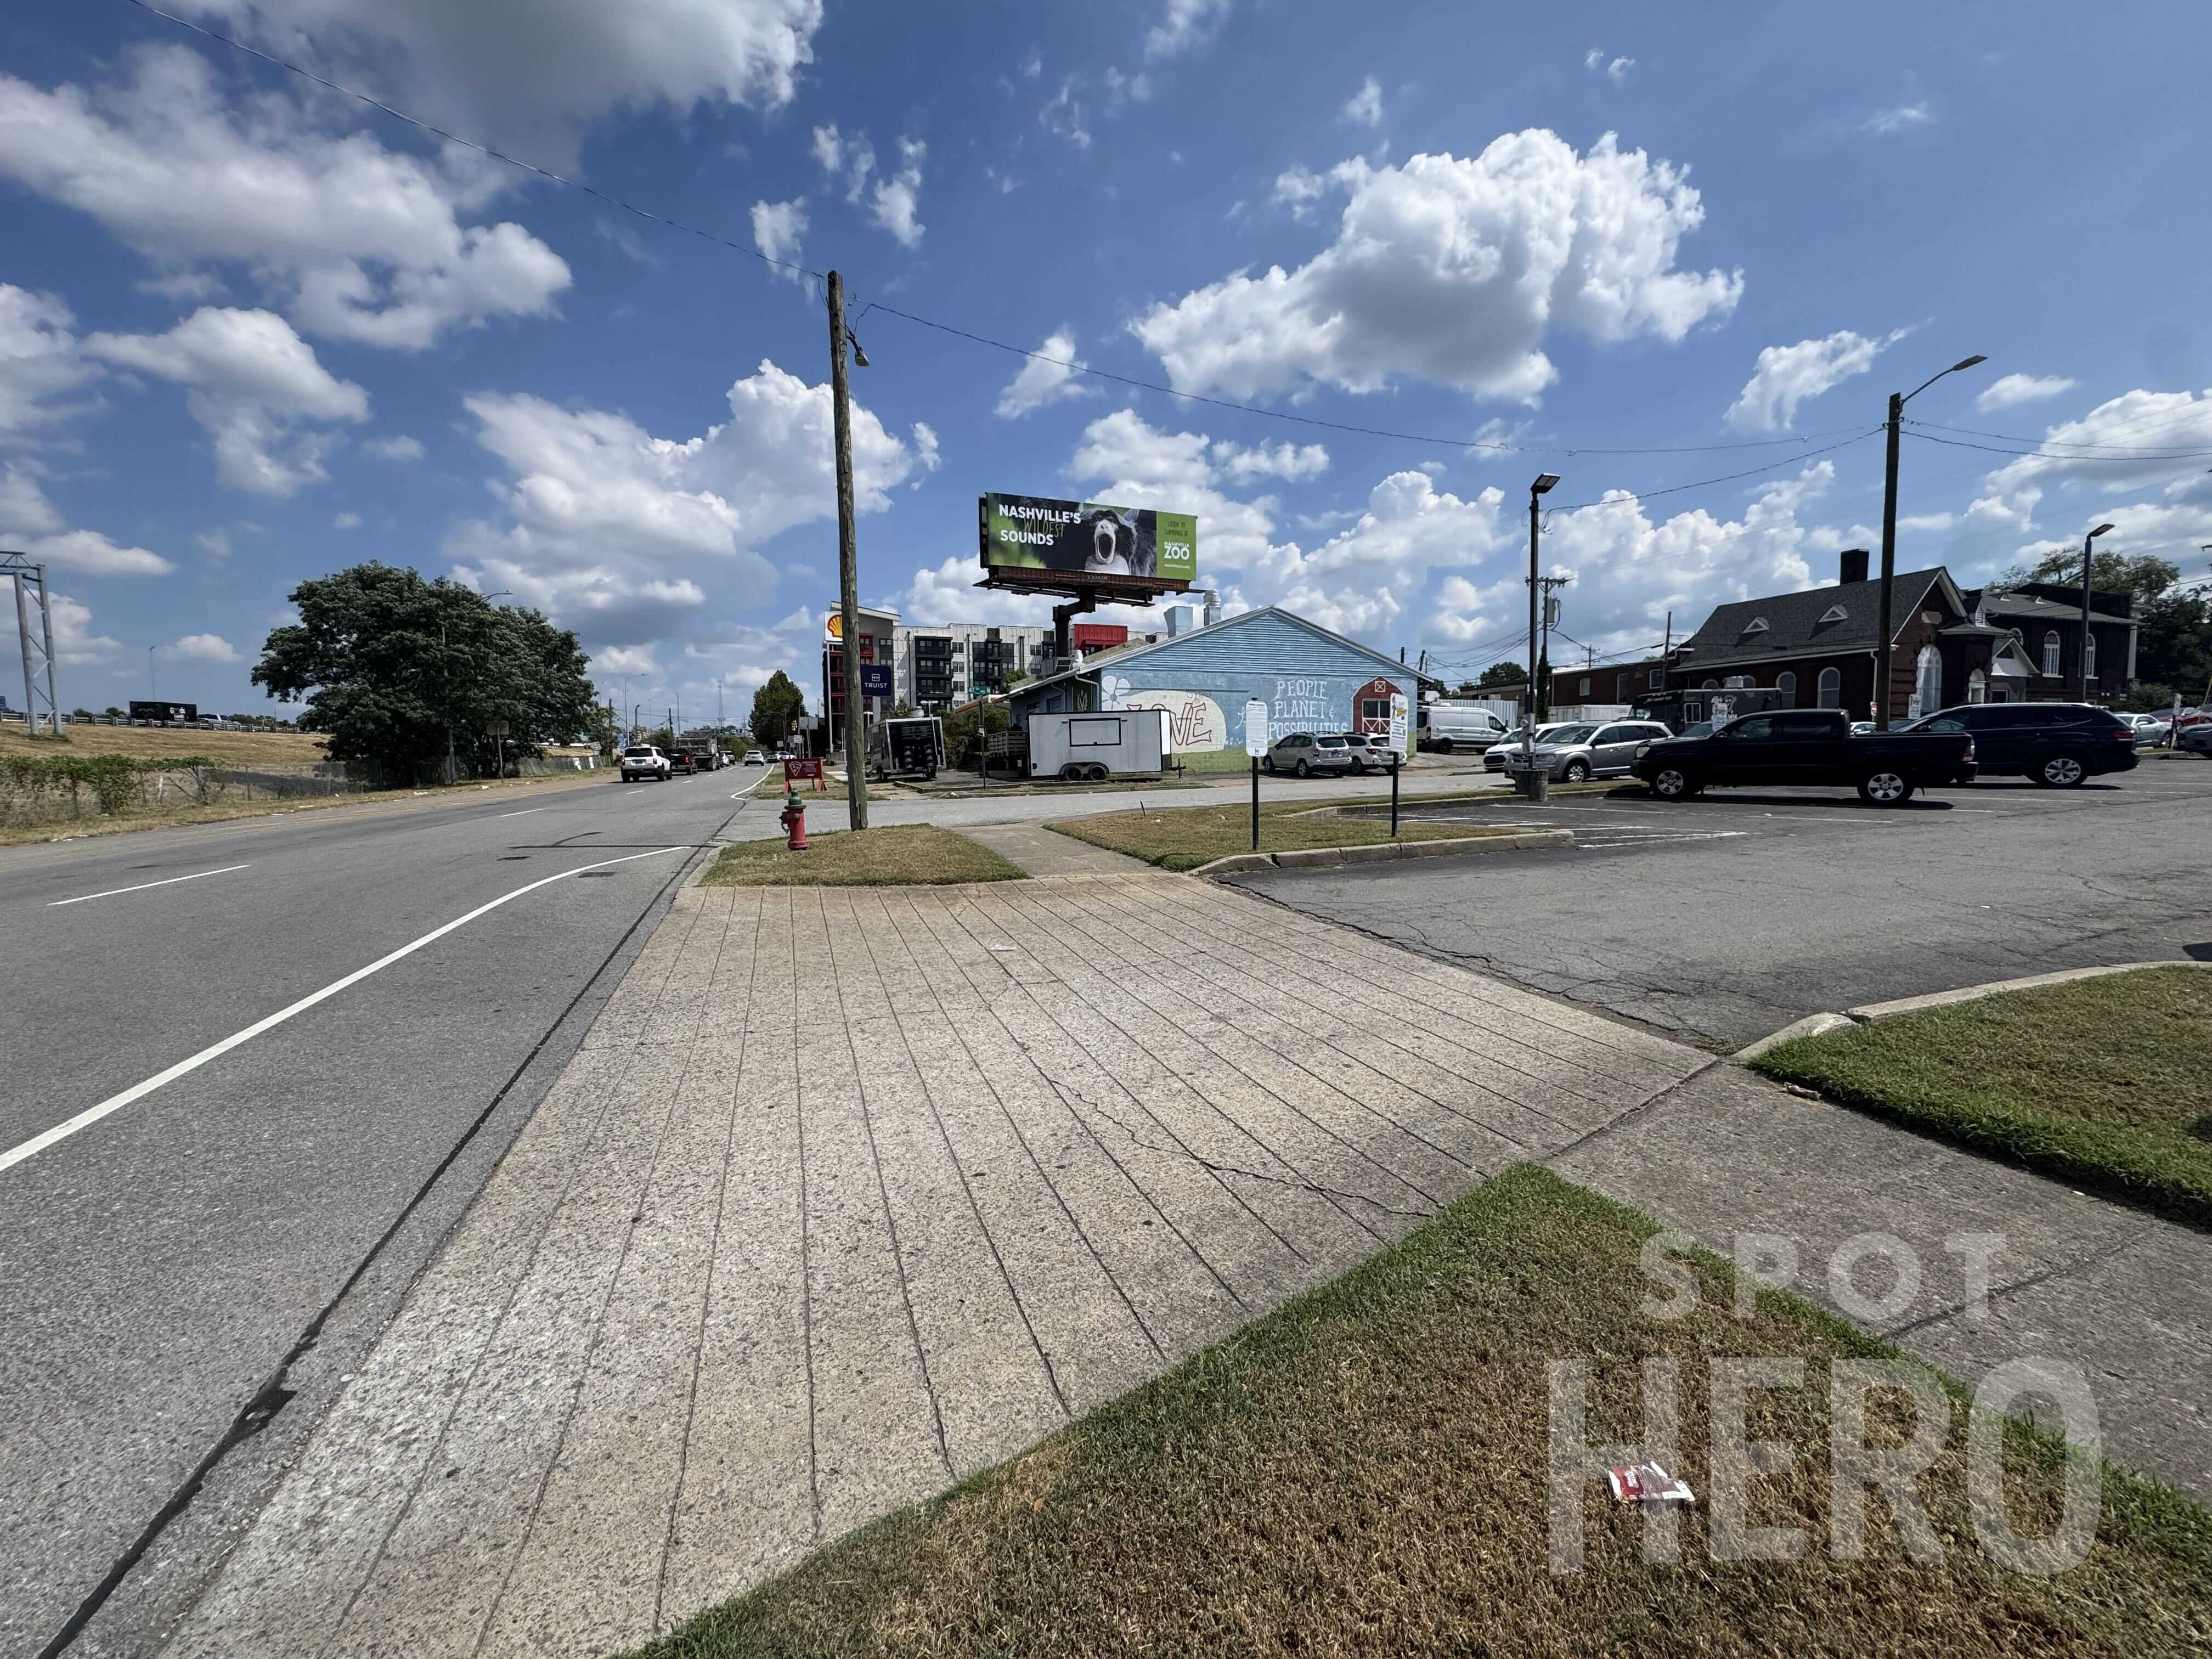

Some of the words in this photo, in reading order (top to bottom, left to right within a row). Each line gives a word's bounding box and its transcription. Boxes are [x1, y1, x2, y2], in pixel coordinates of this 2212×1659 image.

[999, 504, 1081, 524] NASHVILLE'S
[1000, 529, 1054, 546] SOUNDS
[1024, 518, 1066, 538] WILDEST
[1164, 546, 1190, 560] ZOO
[1273, 699, 1327, 719] PLANET
